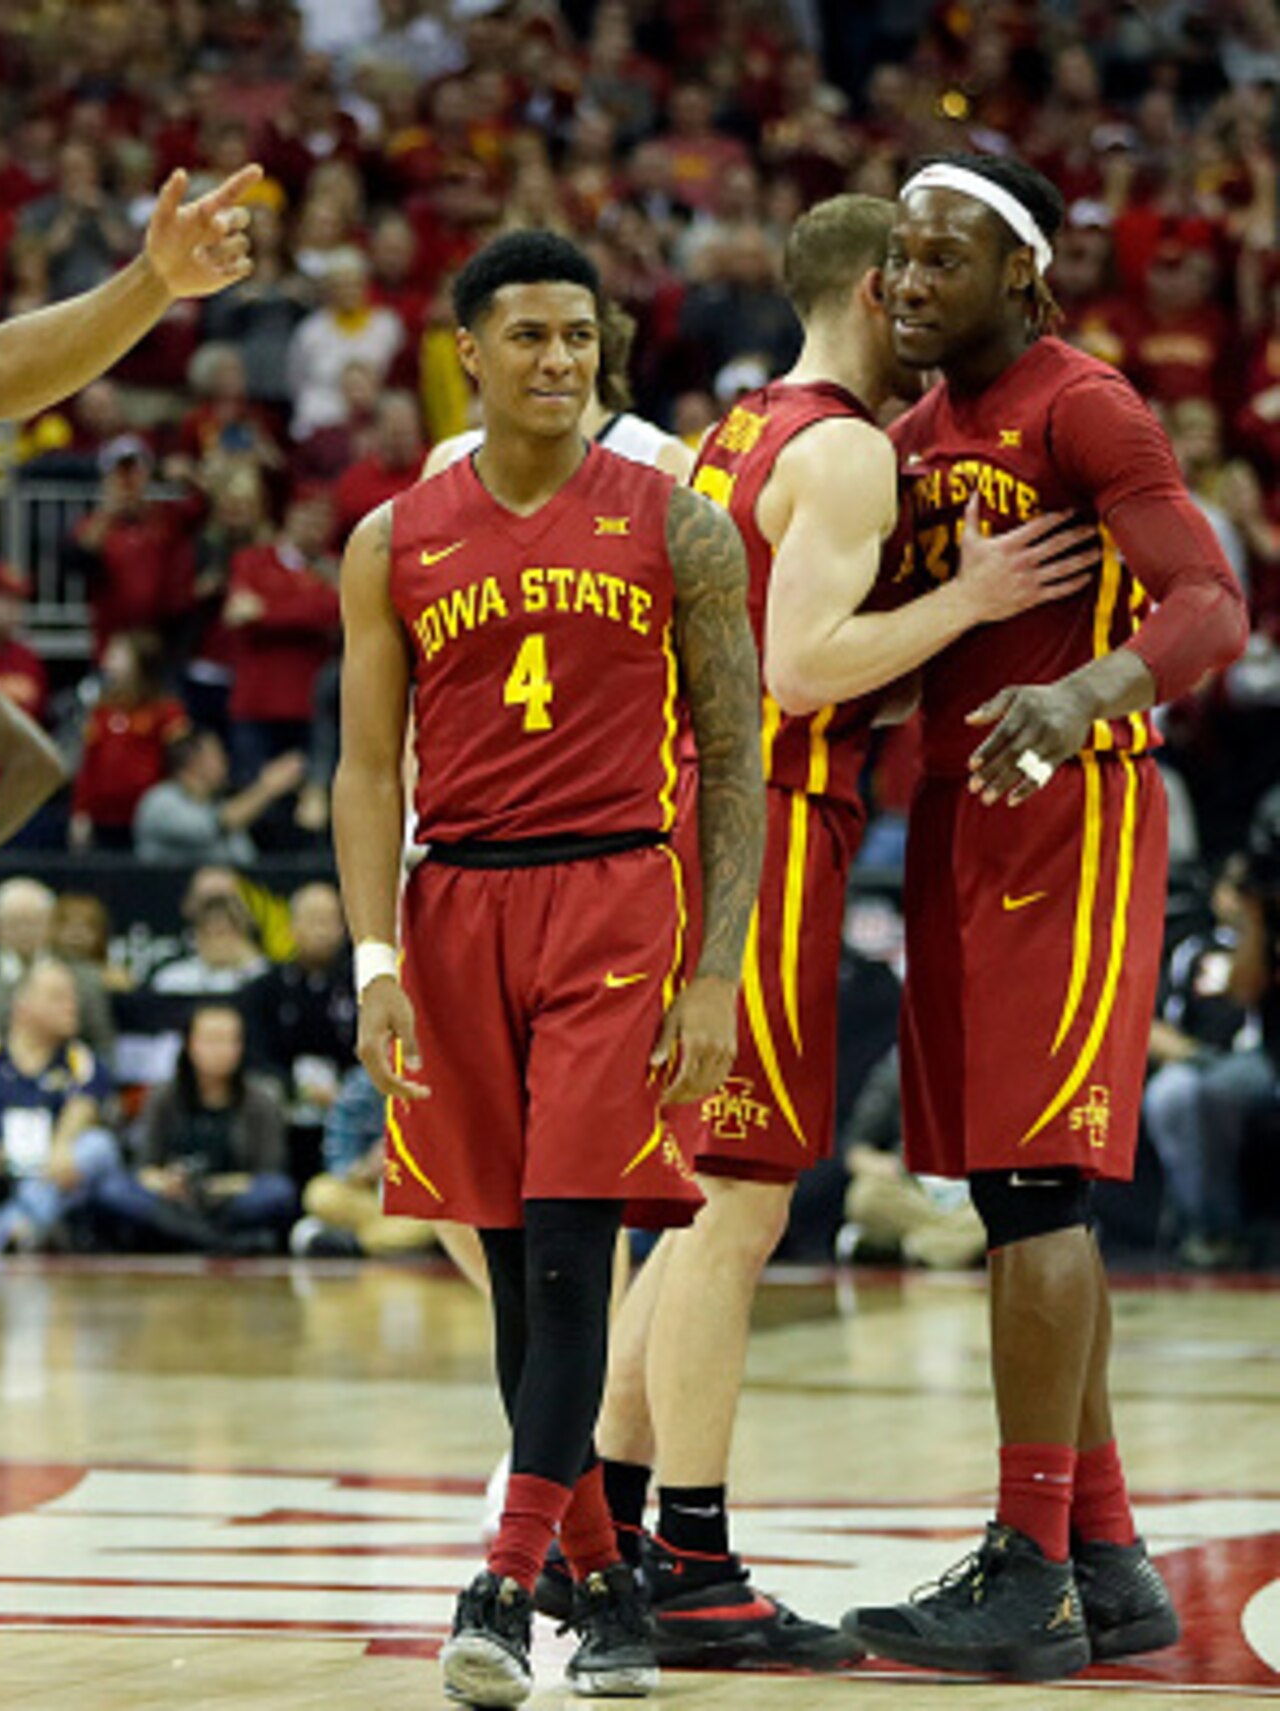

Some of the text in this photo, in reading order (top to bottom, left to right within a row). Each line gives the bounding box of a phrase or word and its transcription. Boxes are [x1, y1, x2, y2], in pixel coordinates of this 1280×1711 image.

[413, 568, 652, 662] IOWA STATE
[504, 632, 554, 732] 4
